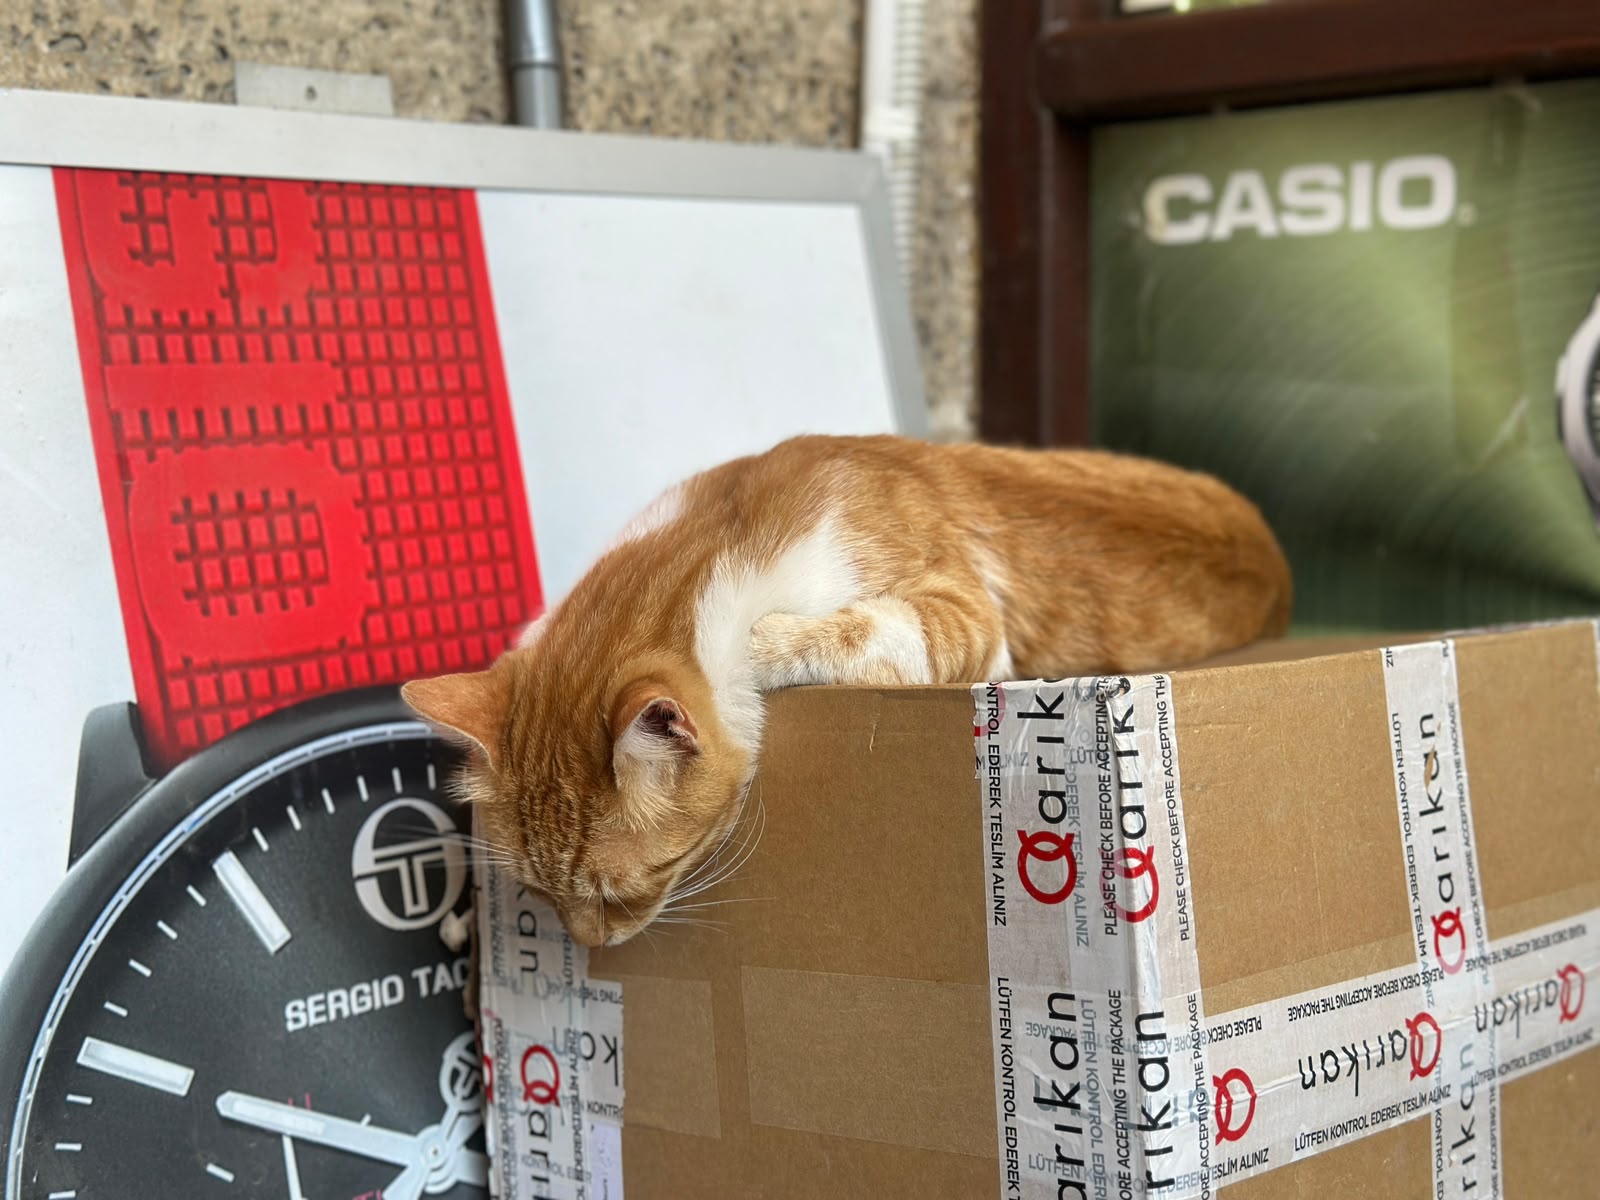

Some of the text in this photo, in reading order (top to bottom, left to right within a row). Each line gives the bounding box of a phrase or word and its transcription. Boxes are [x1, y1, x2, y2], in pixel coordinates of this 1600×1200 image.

[1144, 154, 1457, 244] CASIO
[1095, 692, 1112, 772] ACCEPTING
[1392, 712, 1405, 769] LÜTFEN
[988, 744, 1002, 809] EDEREK
[1098, 774, 1114, 830] BEFORE
[1153, 674, 1191, 942] PLEASE CHECK BEFORE ACCEPTING THE
[1397, 771, 1413, 842] KONTROL
[990, 811, 1005, 870] TESLİM
[1101, 832, 1116, 881] CHECK
[992, 873, 1007, 927] ALINIZ
[1406, 844, 1420, 903] EDEREK
[1100, 883, 1119, 936] PLEASE
[285, 973, 404, 1032] SERGIO
[997, 977, 1013, 1040] LÜTFEN
[1287, 998, 1320, 1022] PACKAGE
[1320, 994, 1337, 1014] THE
[1336, 986, 1374, 1010] ACCEPTING
[1373, 977, 1399, 999] BEFORE
[1398, 972, 1422, 992] CHECK
[1109, 989, 1124, 1061] PACKAGE
[1187, 993, 1203, 1060] PACKAGE
[1206, 1023, 1233, 1045] CHECK
[1232, 1015, 1262, 1038] PLEASE
[1001, 1041, 1017, 1122] KONTROL
[1112, 1061, 1126, 1087] THE
[1113, 1088, 1131, 1169] ACCEPTING
[1295, 1128, 1329, 1151] LÜTFEN
[1330, 1116, 1370, 1143] KONTROL
[1371, 1104, 1402, 1129] EDEREK
[1434, 1108, 1445, 1180] KONTROL
[1005, 1126, 1021, 1189] EDEREK
[1239, 1147, 1270, 1173] ALINIZ
